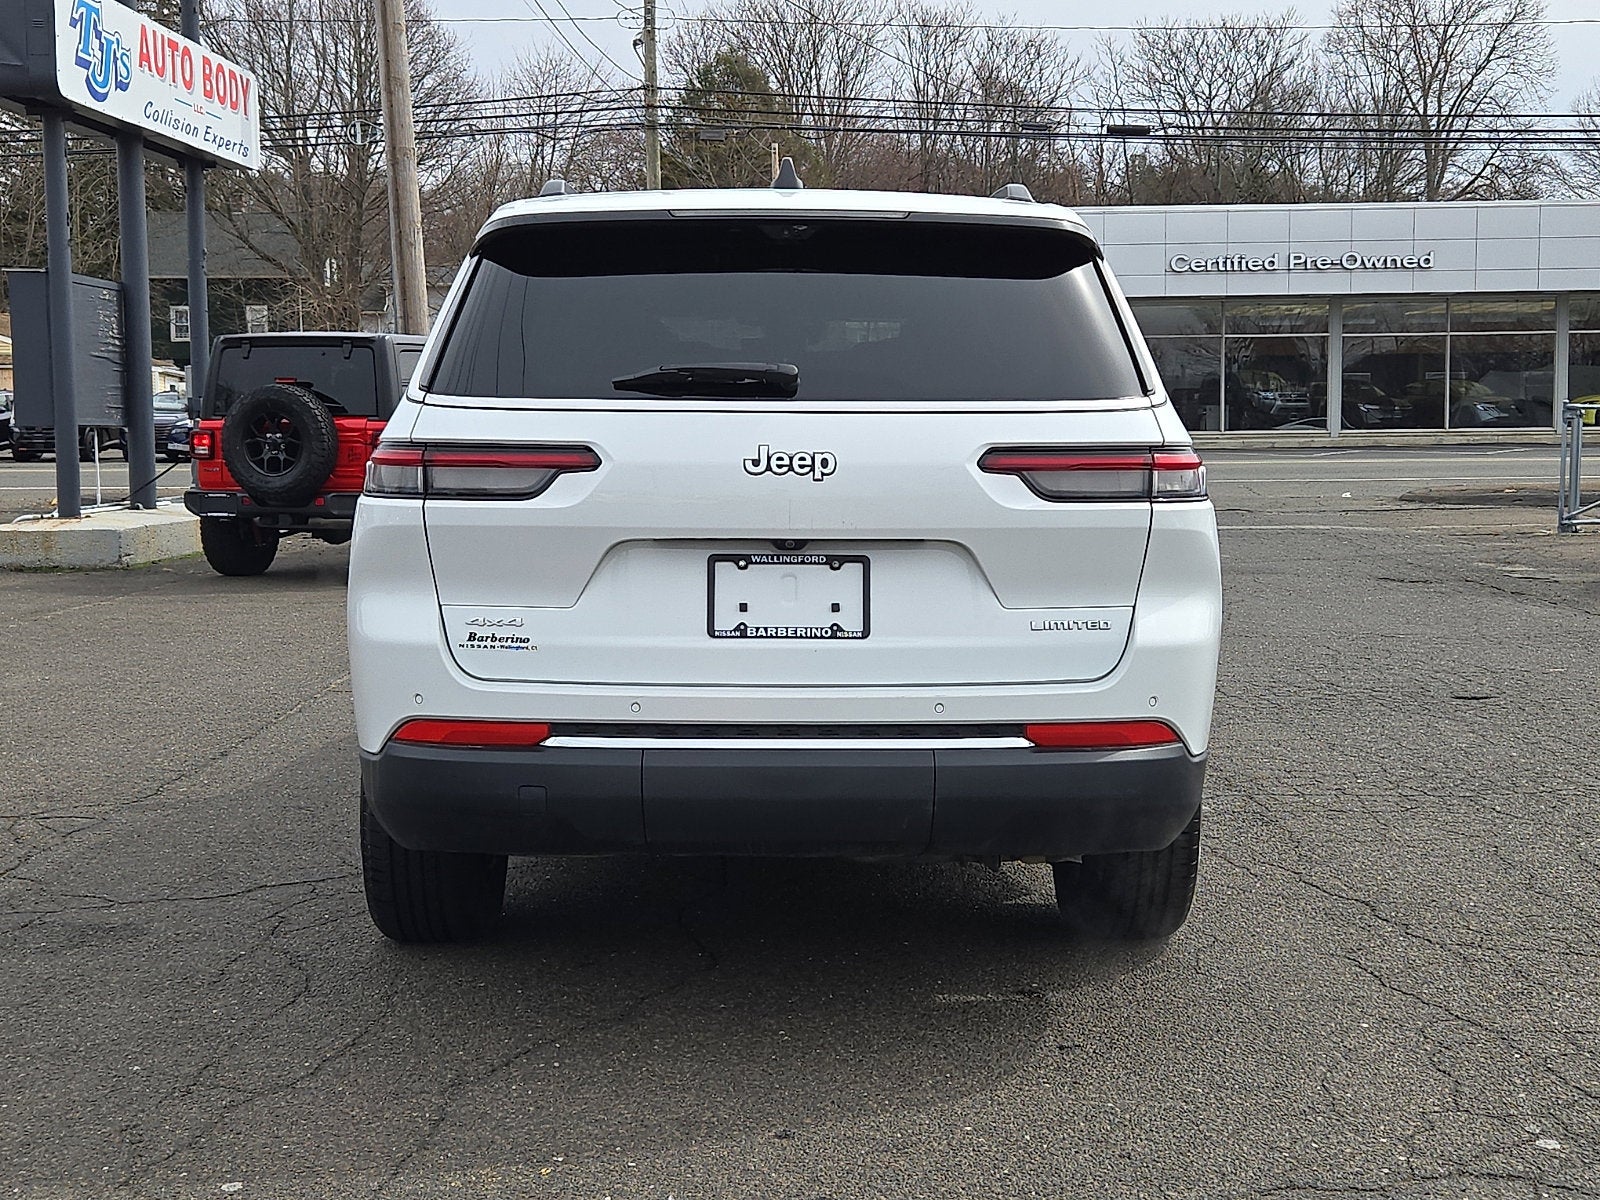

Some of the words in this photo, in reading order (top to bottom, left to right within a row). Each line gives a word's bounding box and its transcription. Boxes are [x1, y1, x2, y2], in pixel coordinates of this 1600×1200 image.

[69, 0, 132, 102] TJ's
[138, 23, 195, 95] AUTO
[202, 55, 250, 118] BODY
[143, 101, 199, 138] Collision
[203, 125, 250, 158] Experts
[1170, 253, 1280, 273] Certified
[1289, 251, 1436, 271] Pre-Owned
[743, 444, 838, 481] Jeep
[751, 555, 827, 564] WALLINGFORD
[714, 629, 741, 637] NISSAN
[747, 627, 832, 638] BARBERINO
[1029, 619, 1112, 631] LIMITED
[466, 631, 531, 644] Barberino
